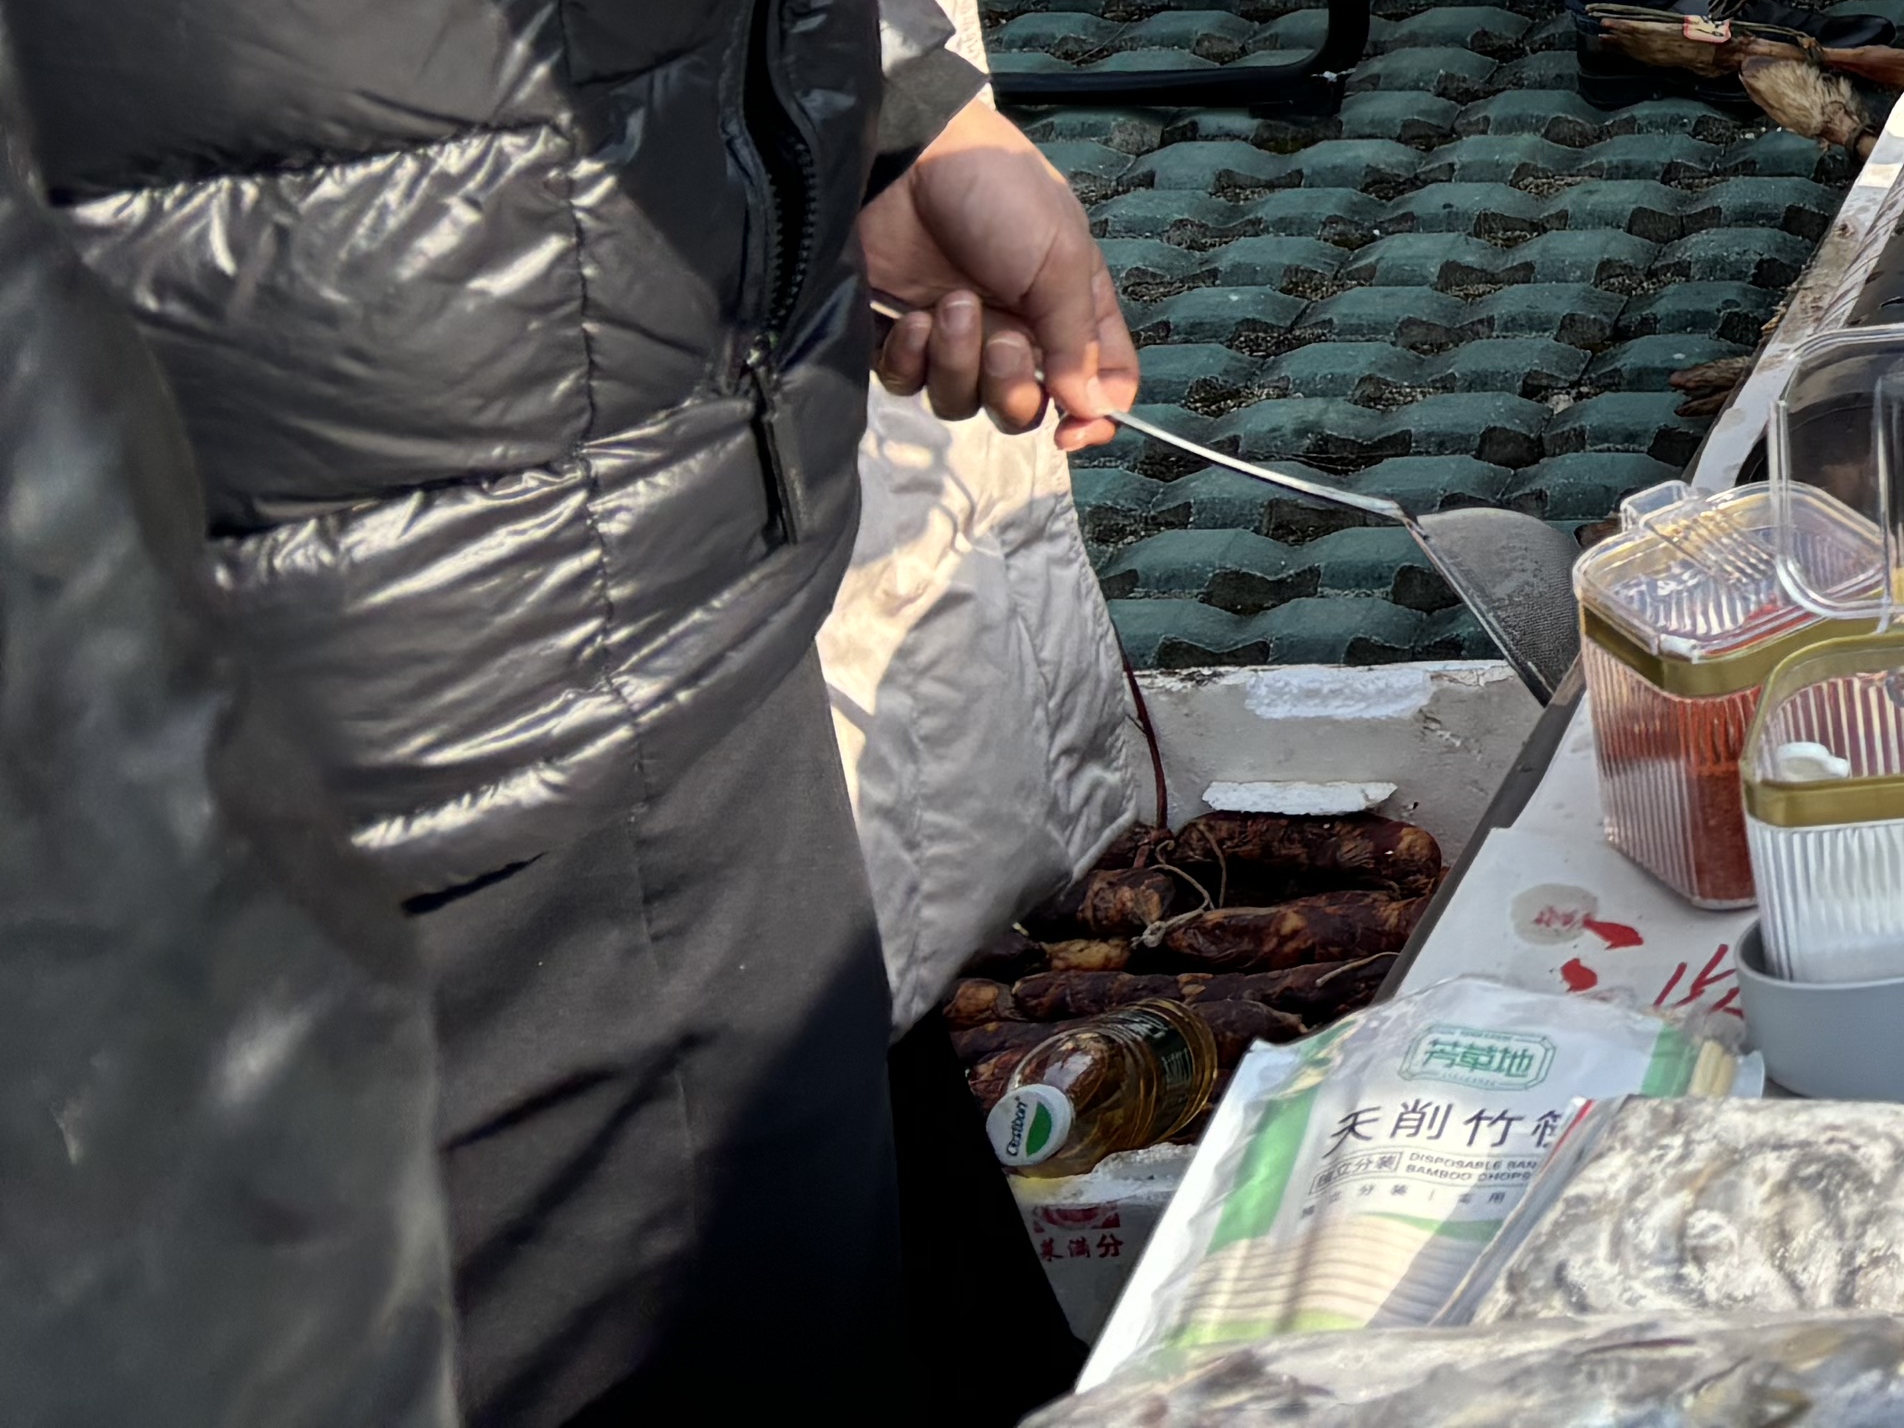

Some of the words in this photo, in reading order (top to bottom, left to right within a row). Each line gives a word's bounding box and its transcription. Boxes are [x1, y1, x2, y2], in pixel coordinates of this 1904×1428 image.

[1423, 1040, 1536, 1079] 芳草地
[1404, 1164, 1472, 1182] BAMBOO
